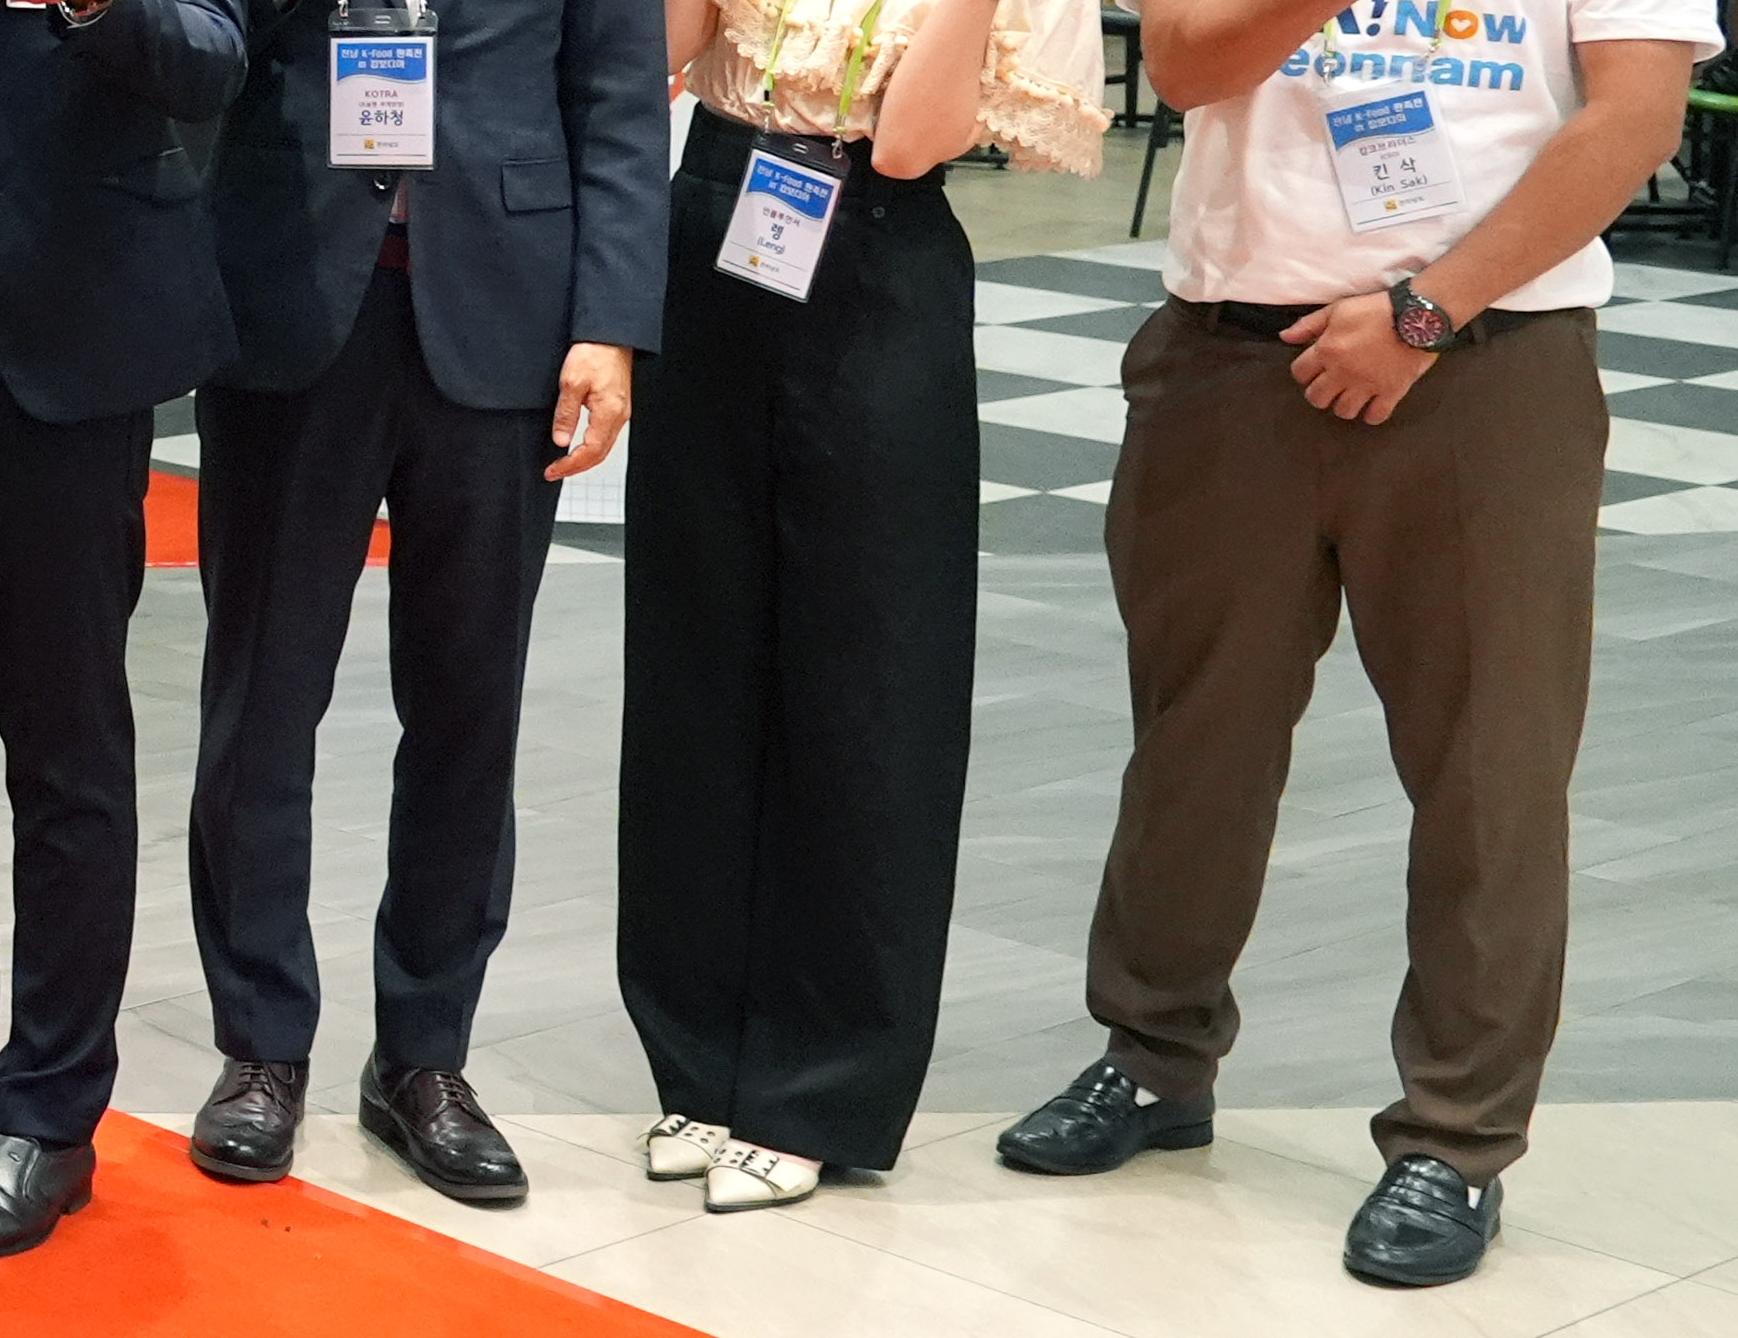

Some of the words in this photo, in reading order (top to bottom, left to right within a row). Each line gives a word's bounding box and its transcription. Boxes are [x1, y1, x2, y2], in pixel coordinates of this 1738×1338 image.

[1279, 48, 1524, 92] eonnam
[1373, 163, 1390, 180] 킨
[1400, 157, 1417, 173] 삭
